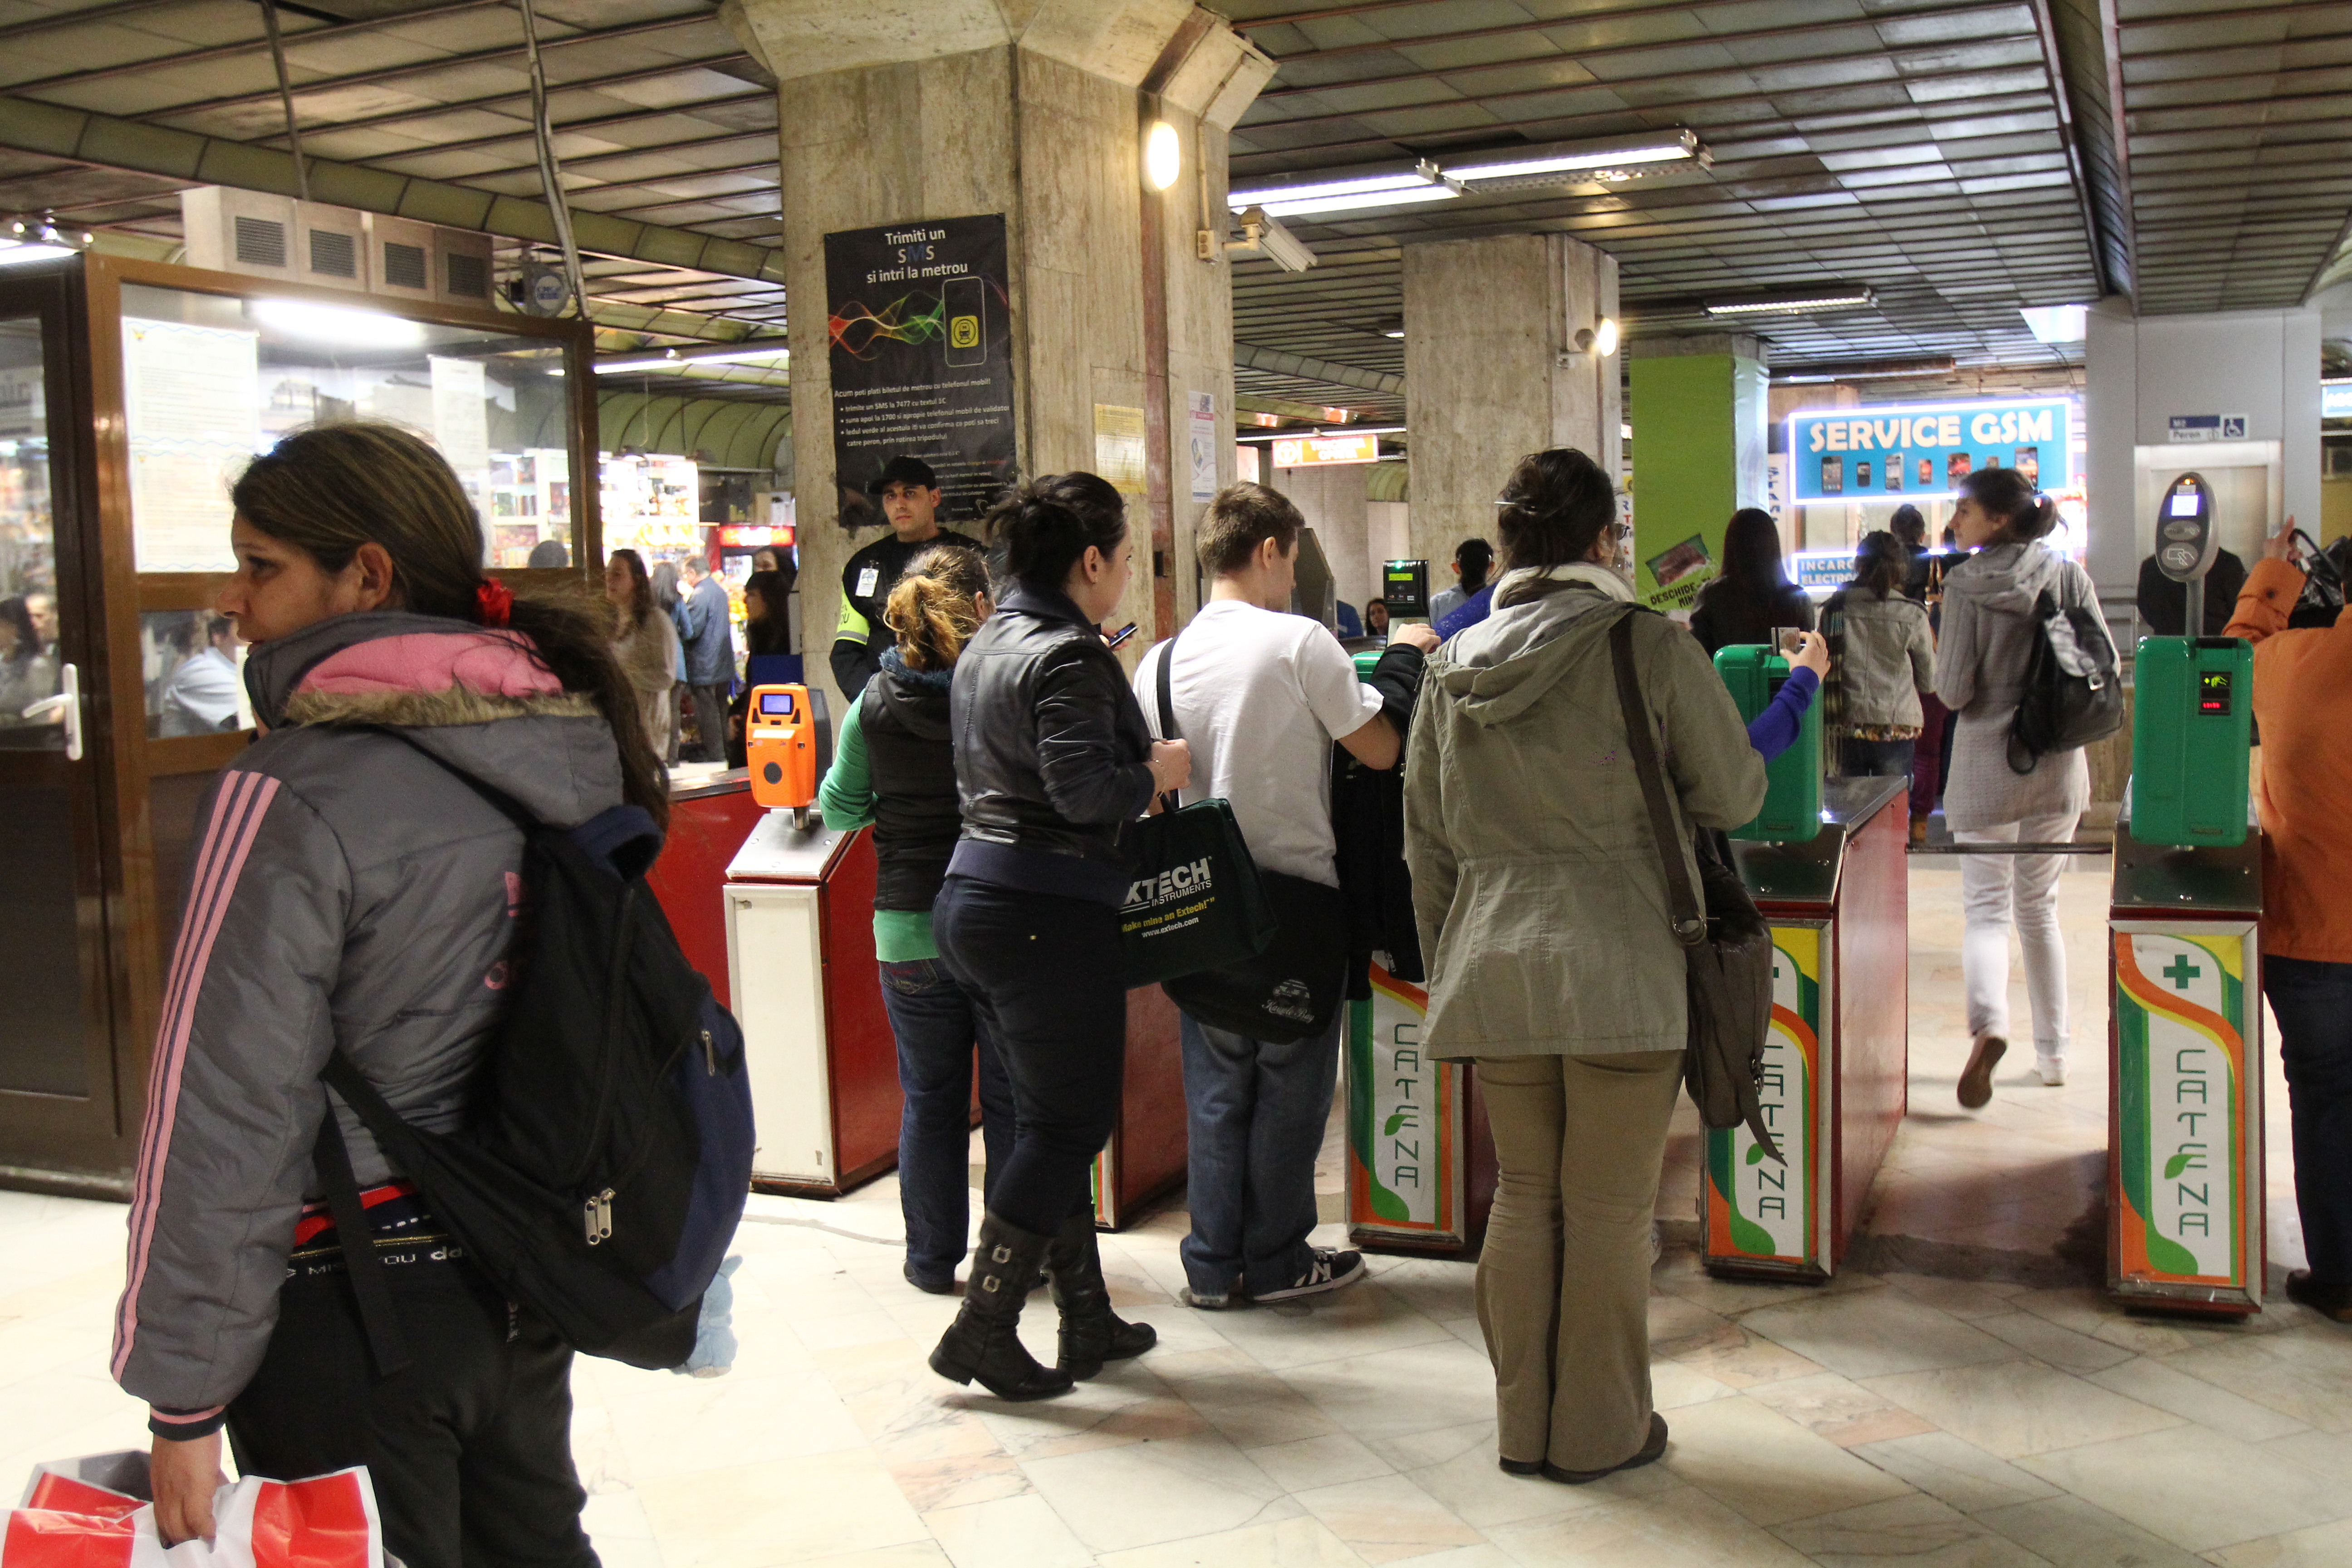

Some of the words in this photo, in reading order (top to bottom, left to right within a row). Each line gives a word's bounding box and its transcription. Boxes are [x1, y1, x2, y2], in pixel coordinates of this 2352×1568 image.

[885, 229, 926, 245] Trimiti
[929, 229, 946, 240] un
[898, 245, 935, 264] SMS
[867, 270, 877, 284] si
[879, 267, 904, 282] intri
[907, 266, 919, 279] la
[921, 263, 968, 277] metrou
[942, 380, 970, 389] telefonul
[1810, 416, 1961, 453] SERVICE
[1970, 410, 2052, 444] GSM
[1123, 858, 1211, 905] XTECH
[1152, 879, 1212, 906] INSTRUMENTS
[1142, 916, 1199, 938] www.extech.com
[1143, 917, 1162, 926] mine
[1165, 912, 1175, 921] an
[1394, 1023, 1419, 1188] CATENA
[2177, 1049, 2208, 1237] CATENA
